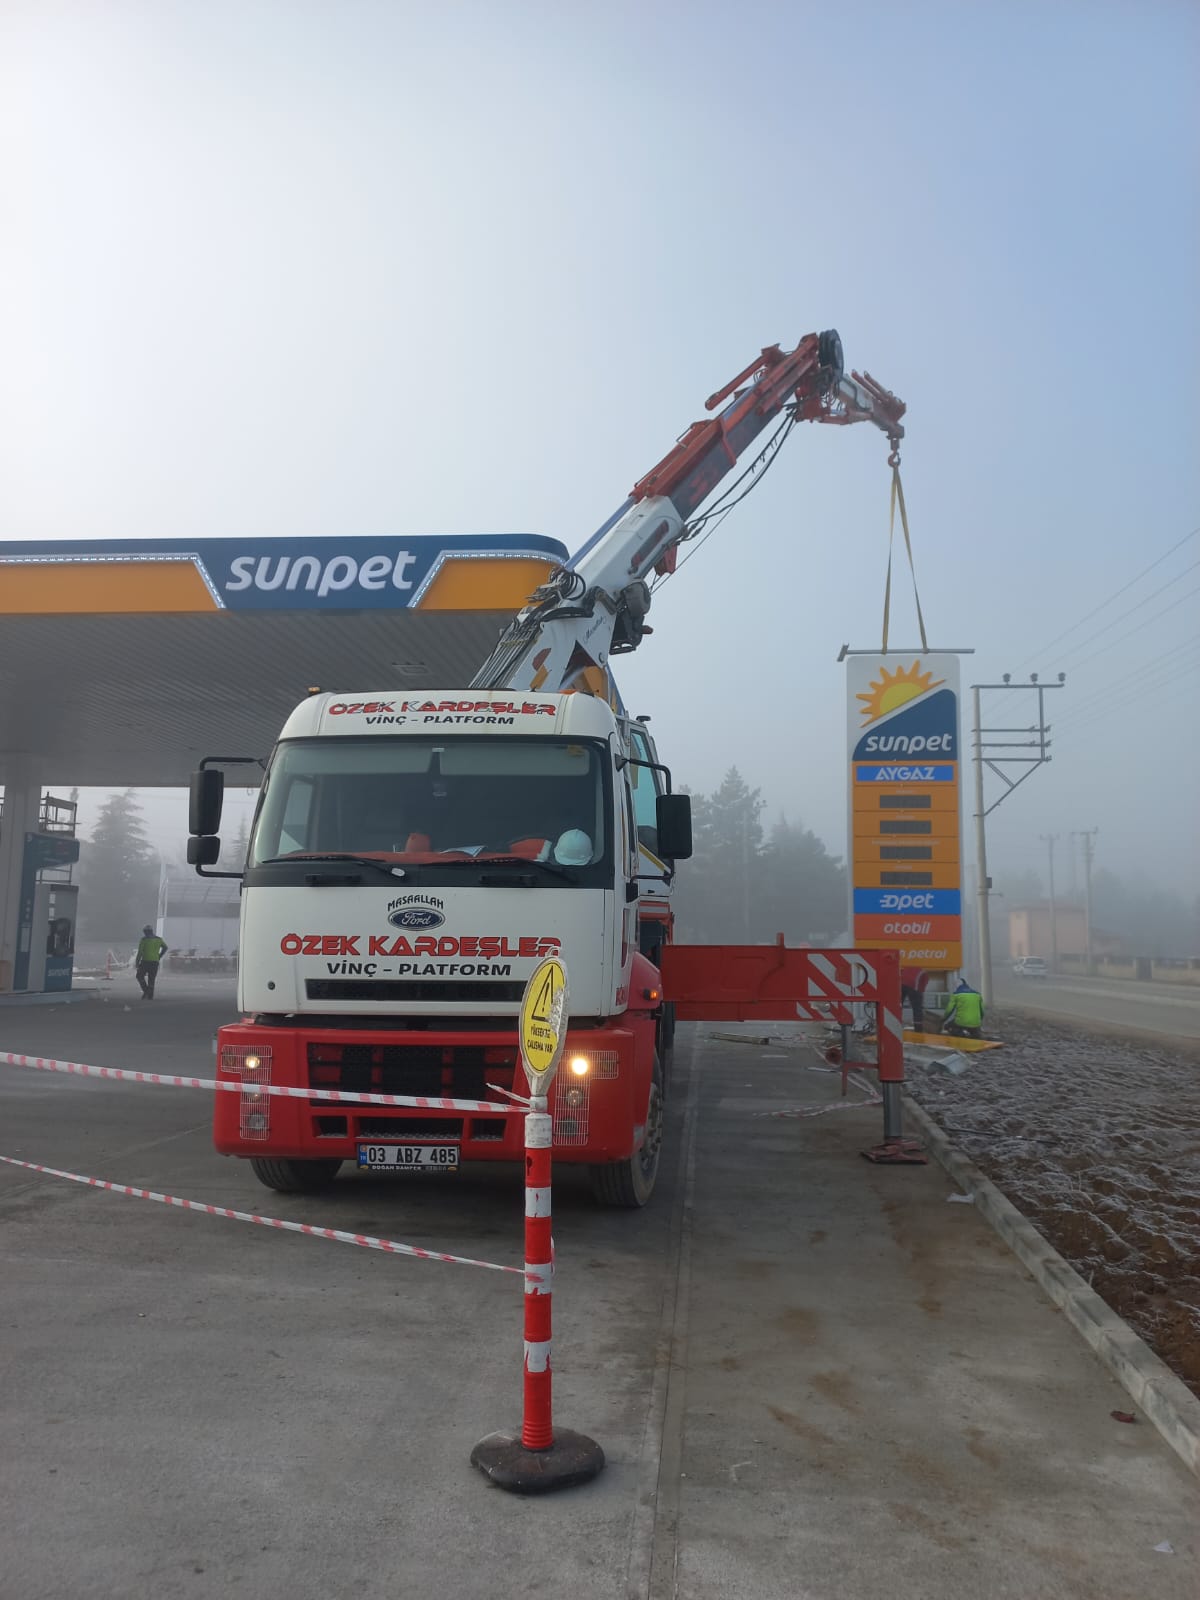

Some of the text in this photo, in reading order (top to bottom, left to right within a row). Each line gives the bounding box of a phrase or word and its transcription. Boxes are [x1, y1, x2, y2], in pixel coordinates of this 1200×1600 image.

[225, 551, 416, 597] sunpet
[366, 714, 407, 725] VİNÇ
[424, 715, 514, 725] PLATFORM
[865, 733, 952, 754] sunpet
[875, 766, 935, 781] AYGAZ
[401, 912, 431, 926] Ford
[883, 922, 931, 934] otobil
[280, 933, 561, 960] ÖZEK KARDEŞLER
[908, 948, 947, 960] petrol
[326, 959, 377, 978] VİNÇ
[398, 962, 511, 976] PLATFORM
[368, 1147, 456, 1163] 03 ABZ 485
